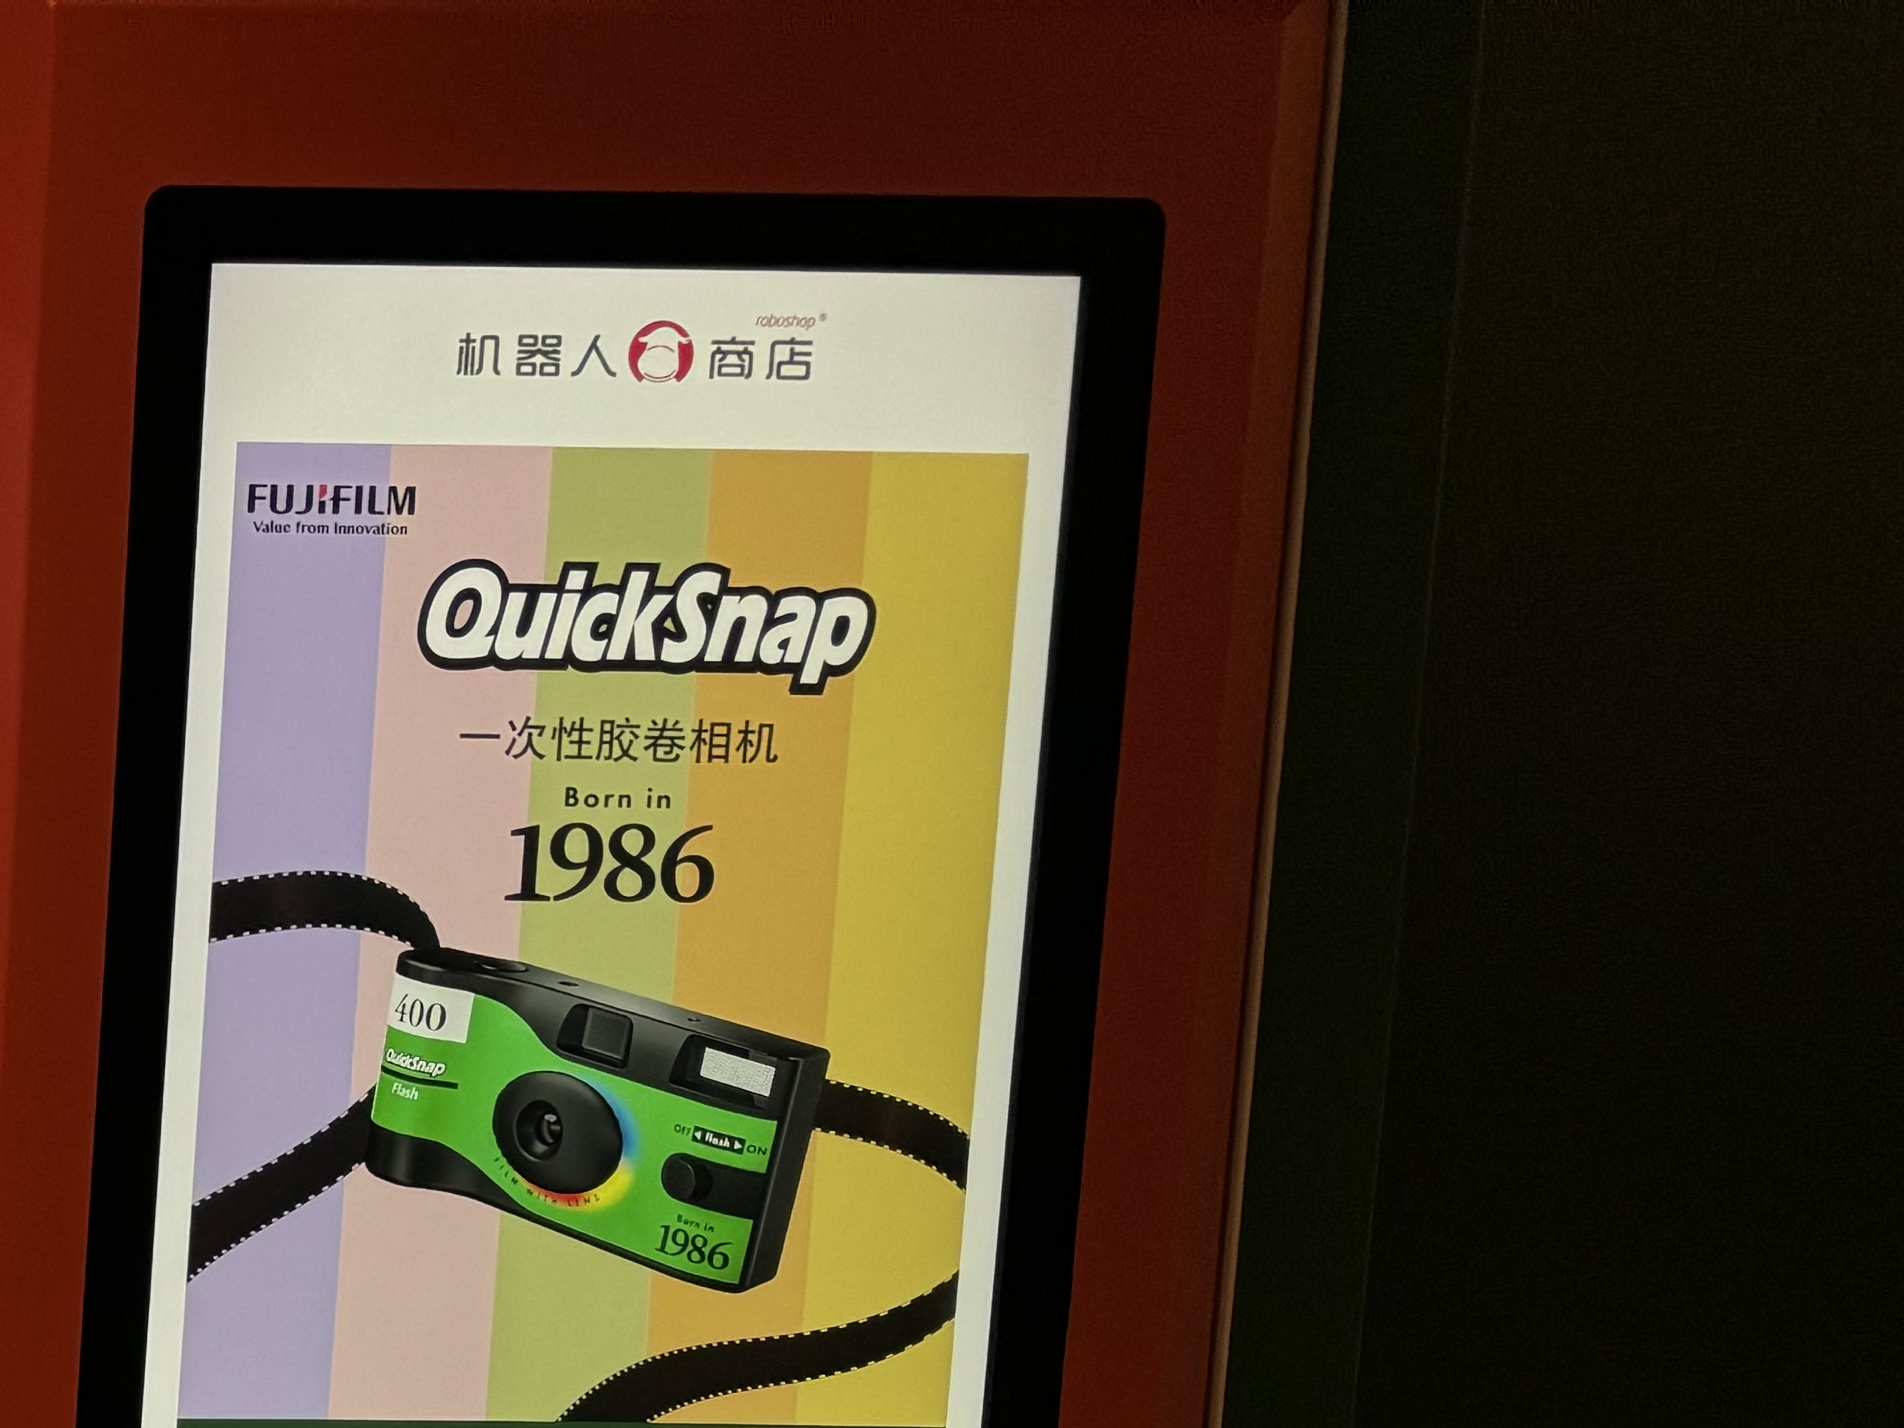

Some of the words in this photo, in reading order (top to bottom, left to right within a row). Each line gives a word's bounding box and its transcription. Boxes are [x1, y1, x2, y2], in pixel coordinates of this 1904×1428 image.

[755, 313, 817, 331] roboshop
[456, 332, 618, 378] 机器人
[708, 336, 814, 381] 商店
[247, 483, 417, 515] FUJIFILM
[253, 520, 292, 534] Value
[296, 521, 329, 535] from
[334, 522, 408, 536] Innovation
[418, 559, 878, 695] QuickSnap
[458, 715, 779, 765] 一次性胶卷相机
[564, 786, 633, 809] Born
[646, 787, 673, 809] in
[503, 822, 716, 904] 1986
[394, 993, 447, 1032] 400
[385, 1048, 447, 1079] QuickSnap
[391, 1082, 419, 1101] Flash
[674, 1123, 692, 1136] OFF
[746, 1144, 768, 1156] ON
[676, 1213, 701, 1229] Born
[703, 1222, 715, 1234] in
[654, 1223, 734, 1271] 1986
